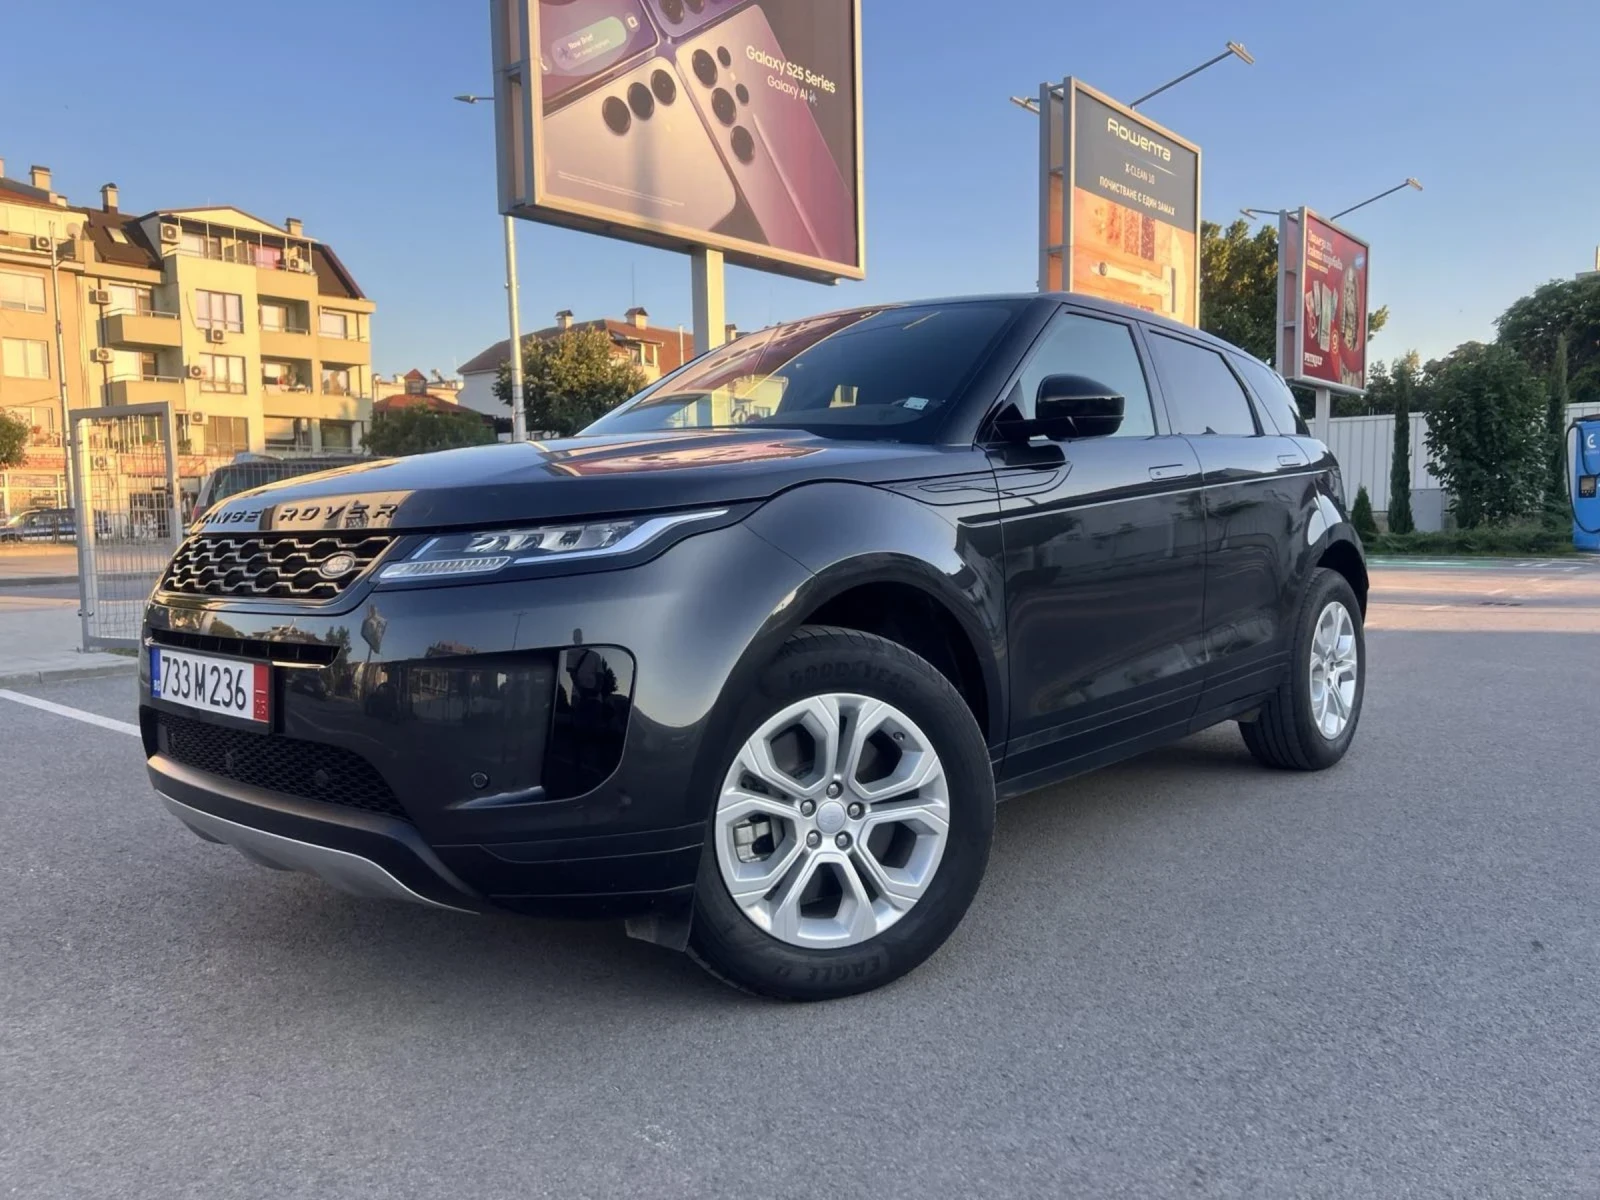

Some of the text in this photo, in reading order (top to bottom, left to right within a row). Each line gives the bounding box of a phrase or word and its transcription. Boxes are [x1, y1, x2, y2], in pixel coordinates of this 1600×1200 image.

[746, 45, 836, 94] Galaxy S25 Series
[767, 75, 808, 100] Galaxy AI
[1099, 175, 1137, 201] ПОЧИСТВАНЕ
[1142, 194, 1158, 209] ЕДИН
[1157, 200, 1175, 216] ЗАМАХ
[279, 503, 399, 521] ROVER
